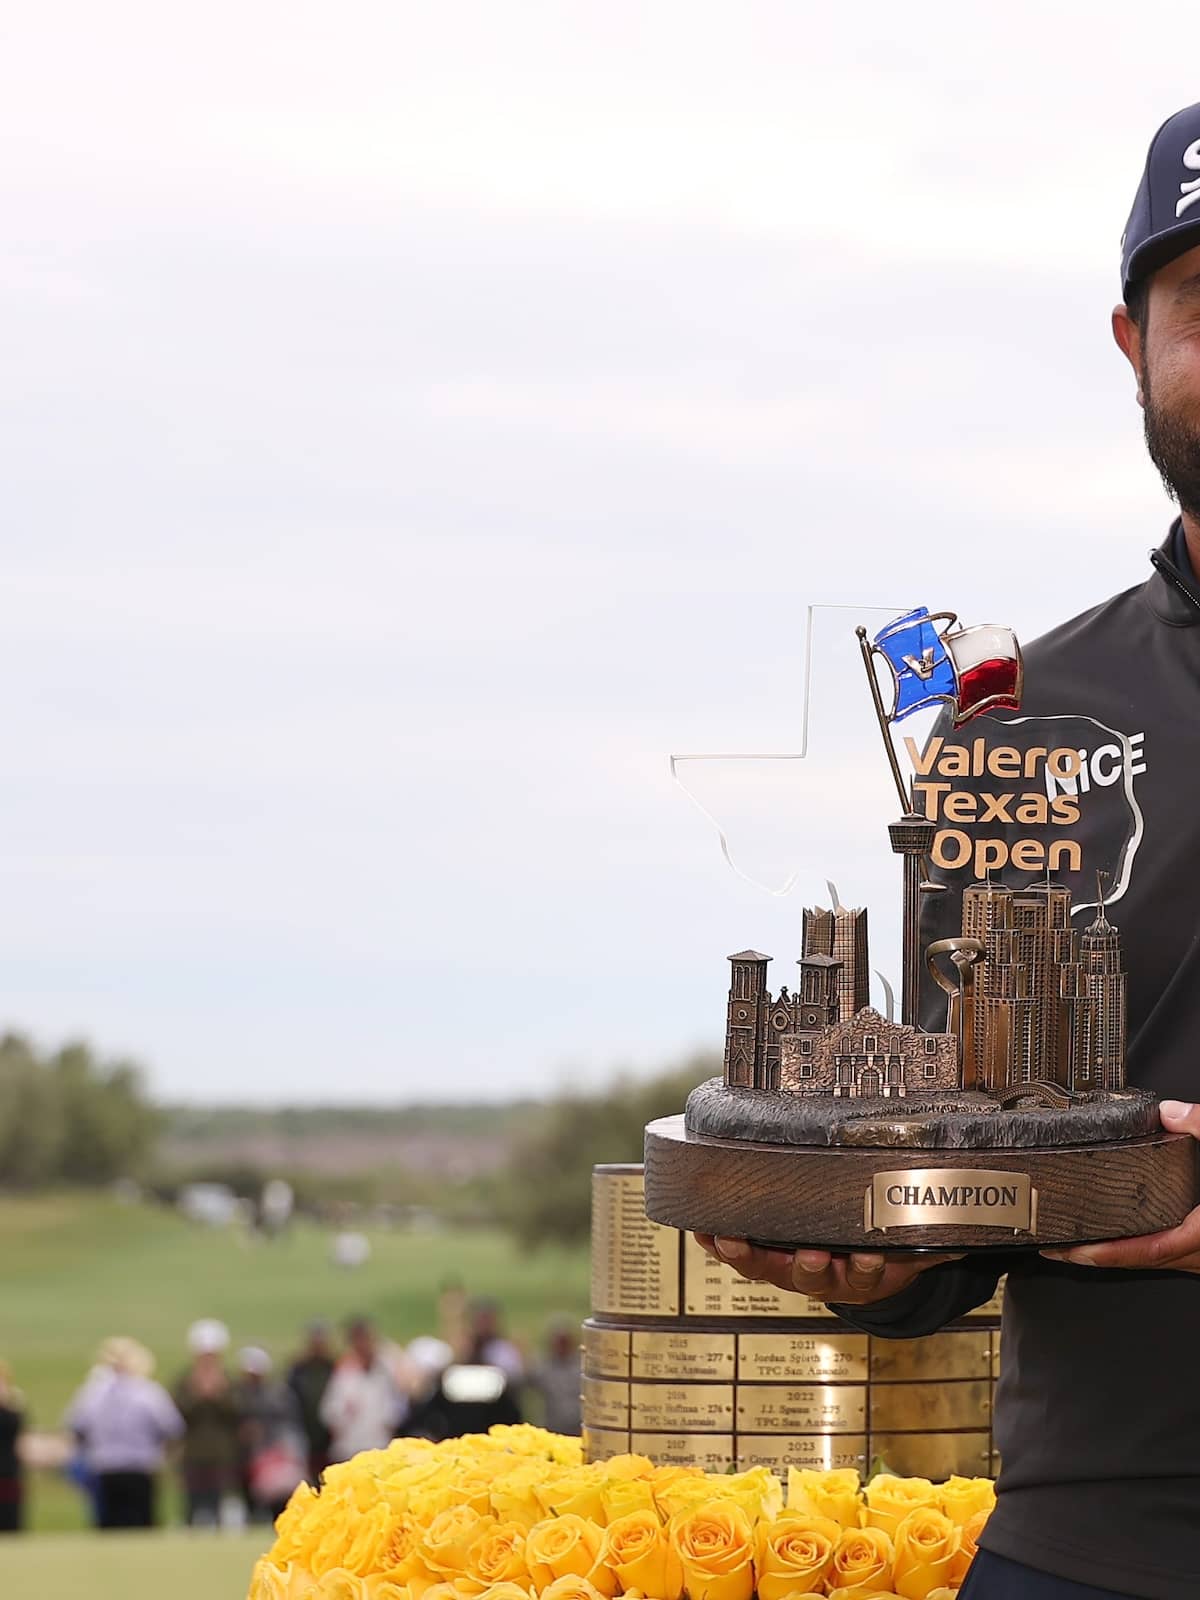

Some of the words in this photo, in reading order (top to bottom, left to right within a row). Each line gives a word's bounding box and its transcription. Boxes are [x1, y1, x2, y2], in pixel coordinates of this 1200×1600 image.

[904, 737, 1082, 778] Valero
[913, 782, 1081, 825] Texas
[930, 829, 1082, 879] Open
[887, 1185, 1018, 1207] CHAMPION
[789, 1340, 816, 1350] 2021
[757, 1366, 781, 1376] TPC
[786, 1391, 816, 1401] 2022
[754, 1416, 779, 1426] TPC
[788, 1442, 815, 1451] 2023
